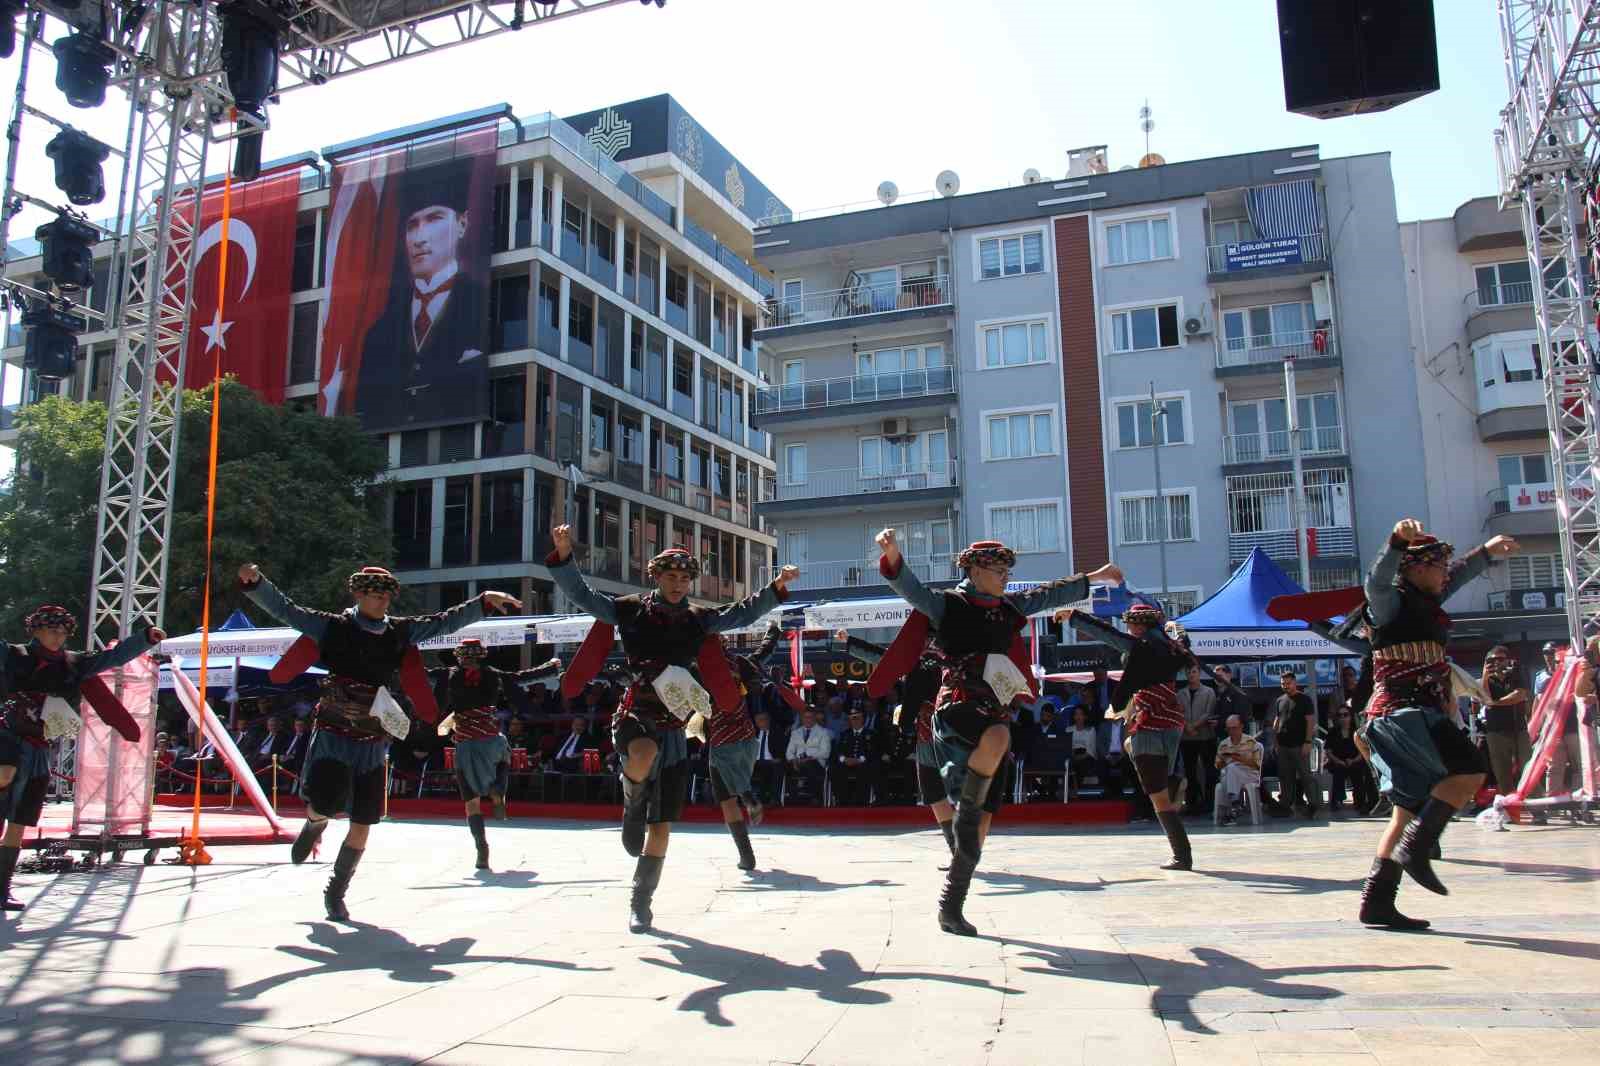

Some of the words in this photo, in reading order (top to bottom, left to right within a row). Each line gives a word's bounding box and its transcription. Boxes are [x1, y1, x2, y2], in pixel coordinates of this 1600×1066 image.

[1272, 239, 1298, 248] TURAN
[875, 610, 902, 621] AYDIN
[1197, 639, 1221, 648] AYDIN
[1222, 637, 1284, 649] BÜYÜKŞEHİR
[1266, 662, 1307, 675] MEYDAN
